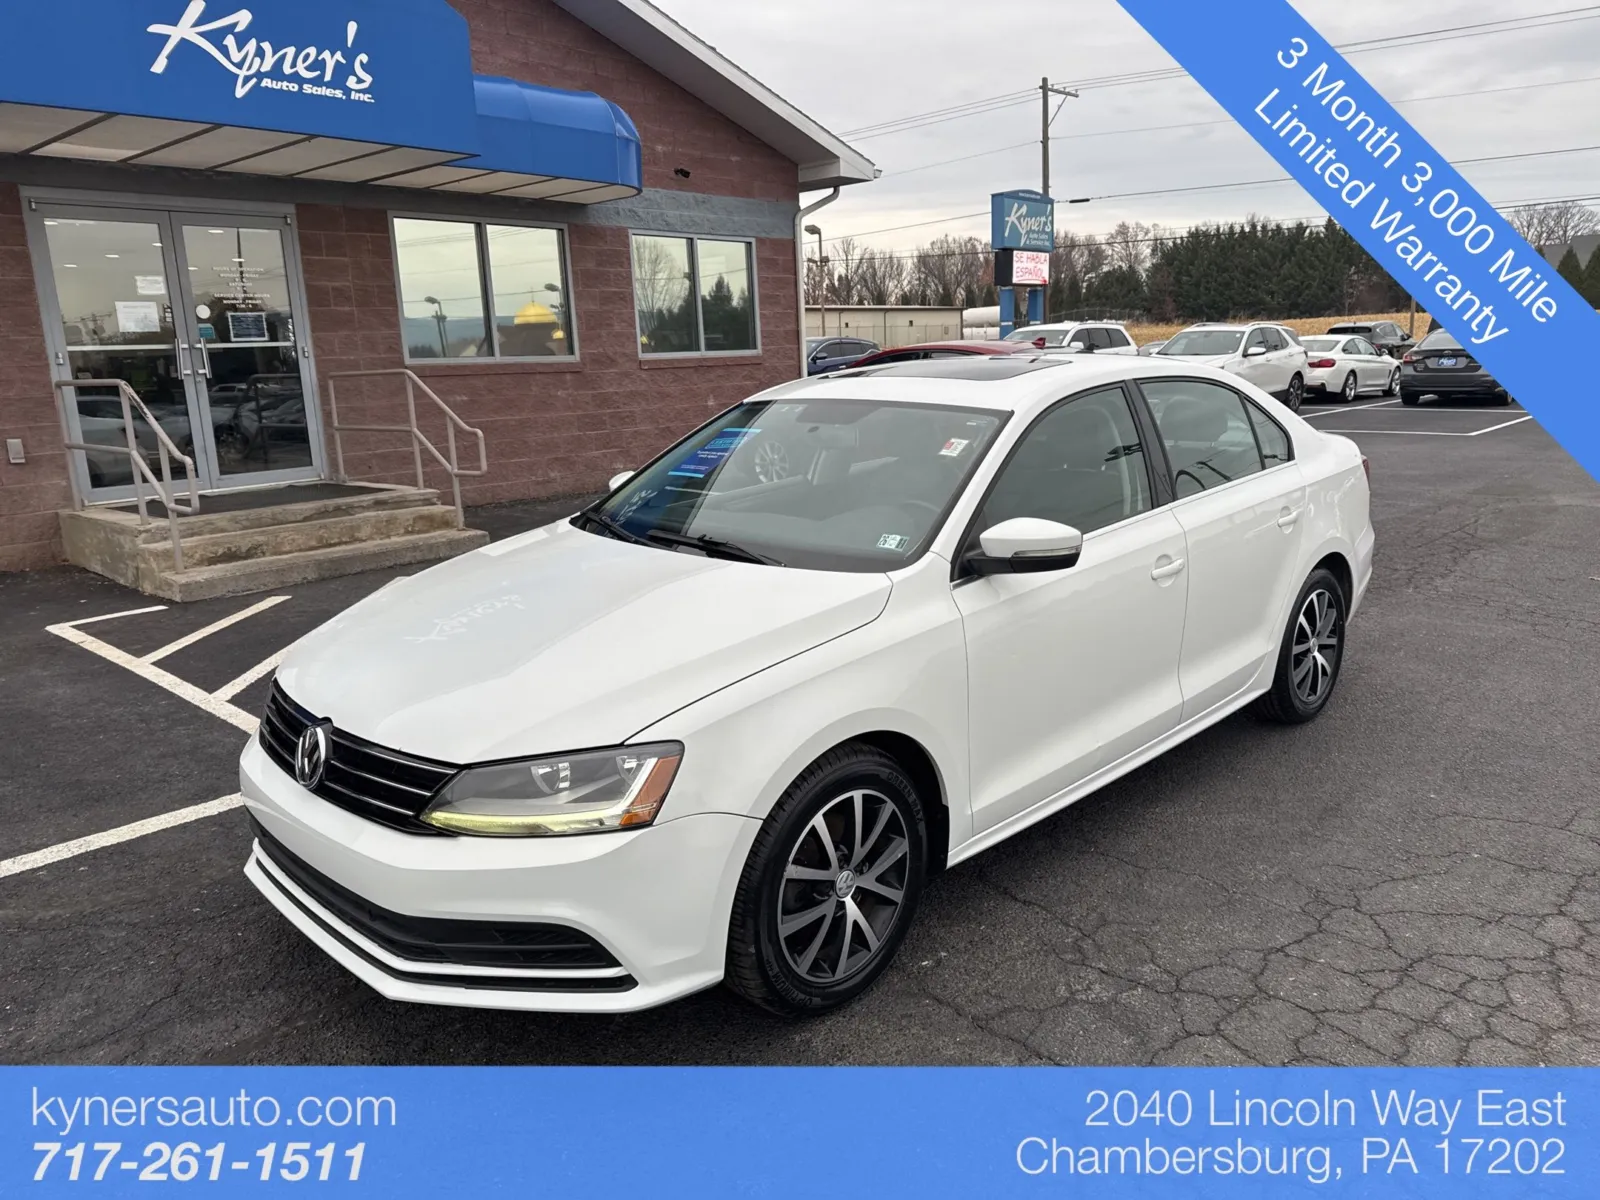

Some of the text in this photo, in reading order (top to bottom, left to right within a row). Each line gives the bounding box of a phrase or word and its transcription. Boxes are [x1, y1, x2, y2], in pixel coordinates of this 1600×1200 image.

[146, 0, 373, 98] Kyner's
[260, 76, 375, 103] Auto Sales, Inc.
[1004, 202, 1052, 247] Kyner's
[1014, 252, 1048, 265] SE HABLA
